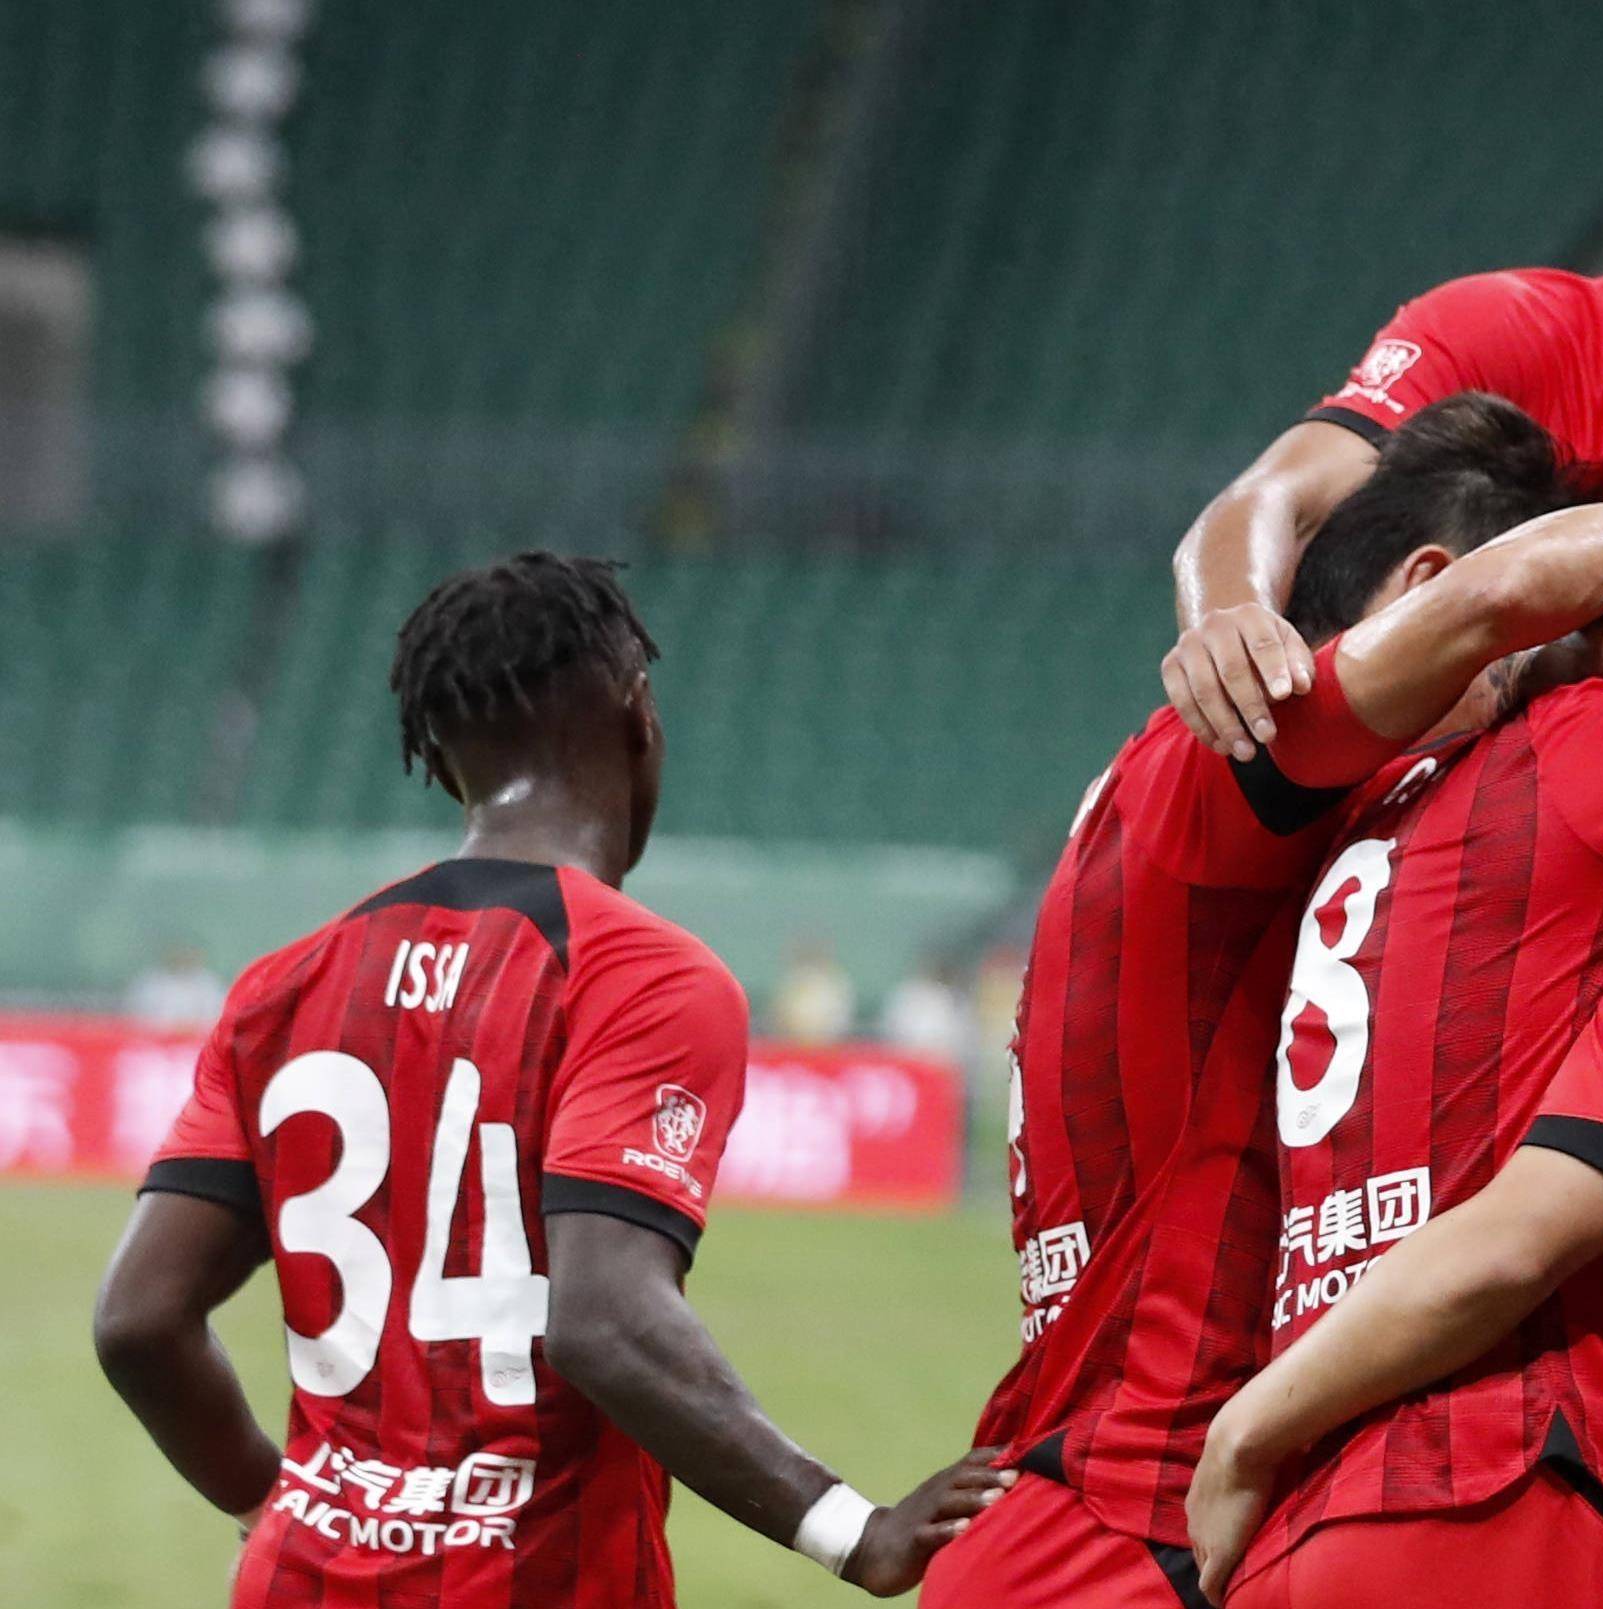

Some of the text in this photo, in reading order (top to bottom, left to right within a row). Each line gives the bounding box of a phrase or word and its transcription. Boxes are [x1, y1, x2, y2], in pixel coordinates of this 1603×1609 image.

[384, 939, 470, 1013] ISSA
[1276, 837, 1397, 1148] 8
[259, 1050, 550, 1407] 34
[1276, 1166, 1432, 1290] 汽集团
[272, 1480, 517, 1556] AIC MOTOR
[280, 1442, 537, 1516] 上汽集团
